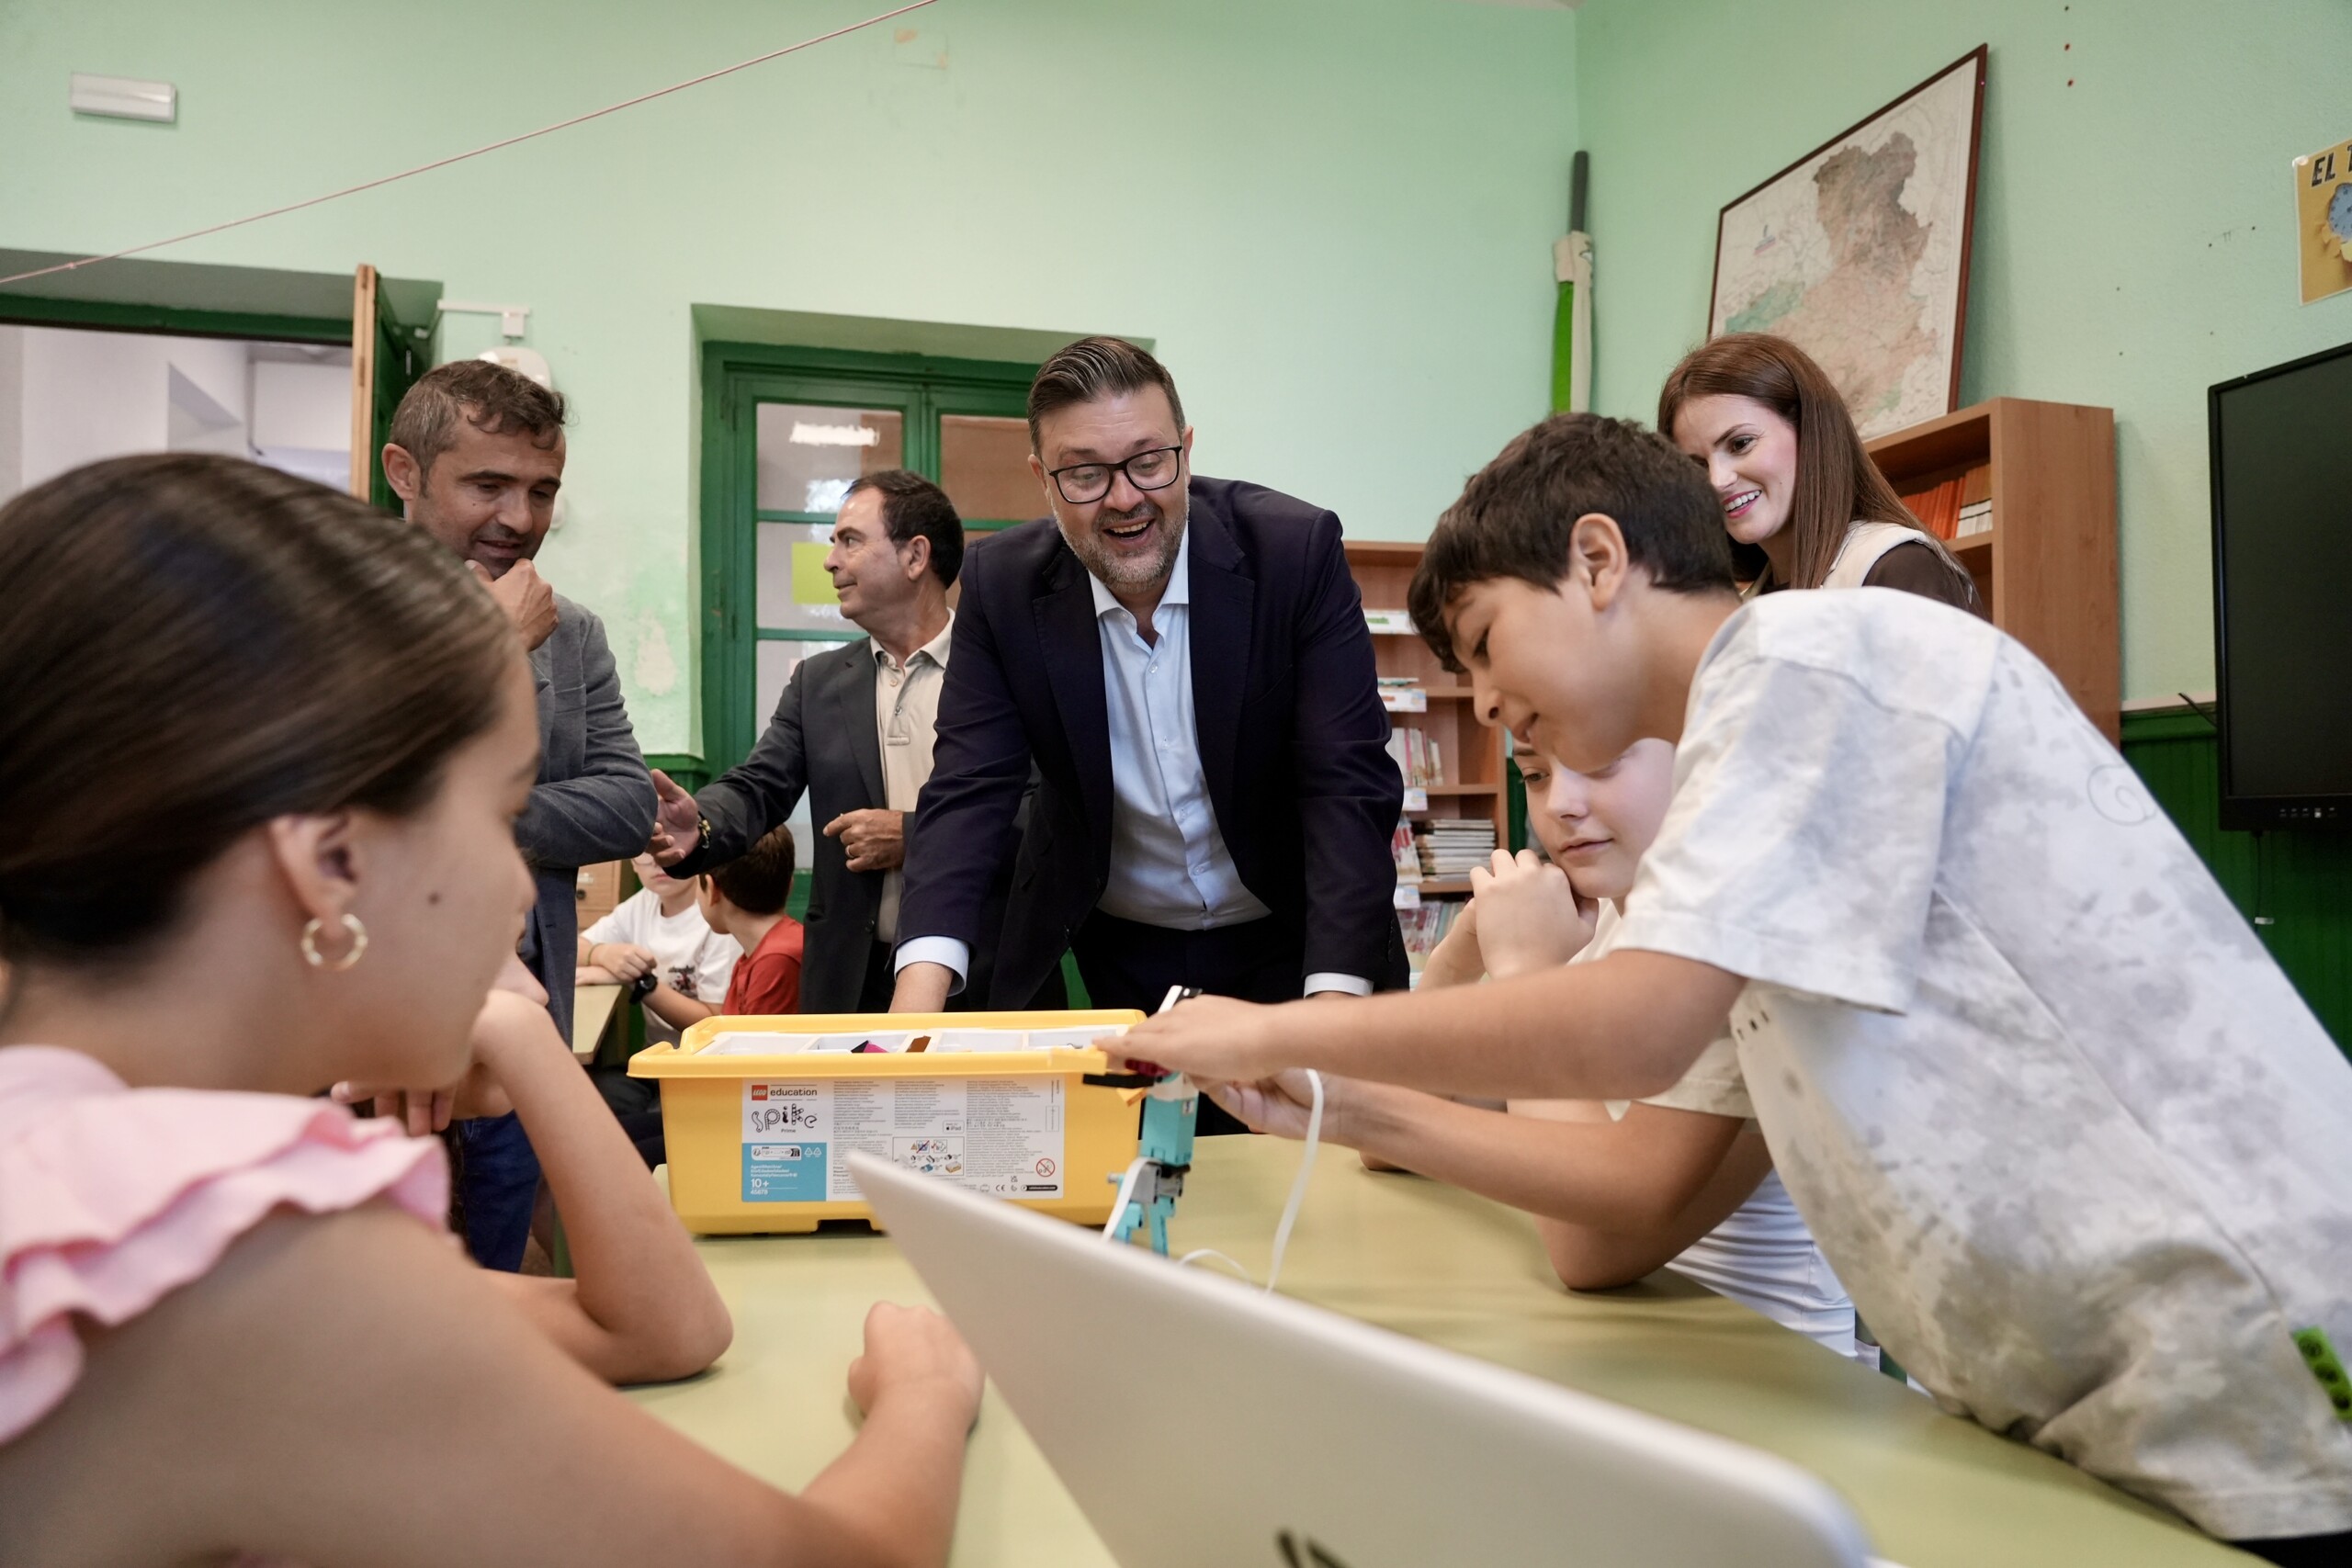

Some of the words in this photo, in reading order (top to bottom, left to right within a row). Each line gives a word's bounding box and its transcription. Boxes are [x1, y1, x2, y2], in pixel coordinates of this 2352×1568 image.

[2312, 152, 2335, 186] EL
[770, 1088, 817, 1096] education
[751, 1178, 769, 1188] 10+
